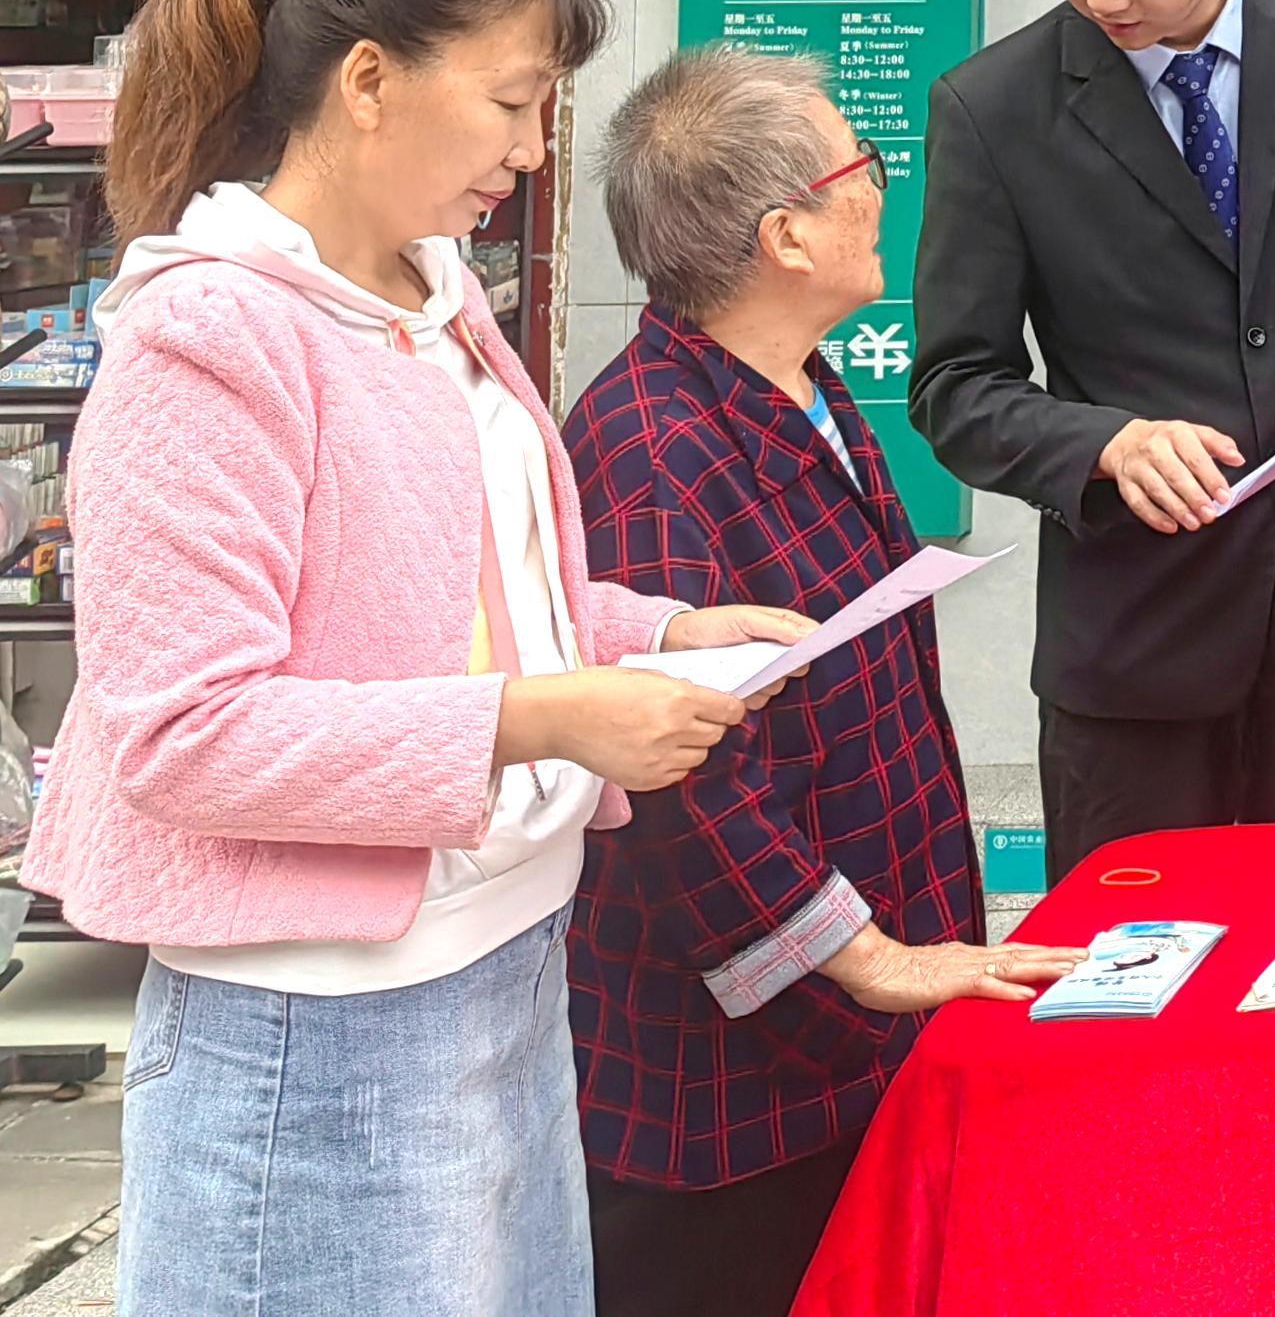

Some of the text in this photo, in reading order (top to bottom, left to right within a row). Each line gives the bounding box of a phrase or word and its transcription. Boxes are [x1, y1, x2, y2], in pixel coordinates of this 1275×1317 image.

[724, 13, 891, 25] 星期一至五 星期一至五
[724, 26, 808, 37] Monday to Friday
[840, 26, 925, 36] Monday to Friday
